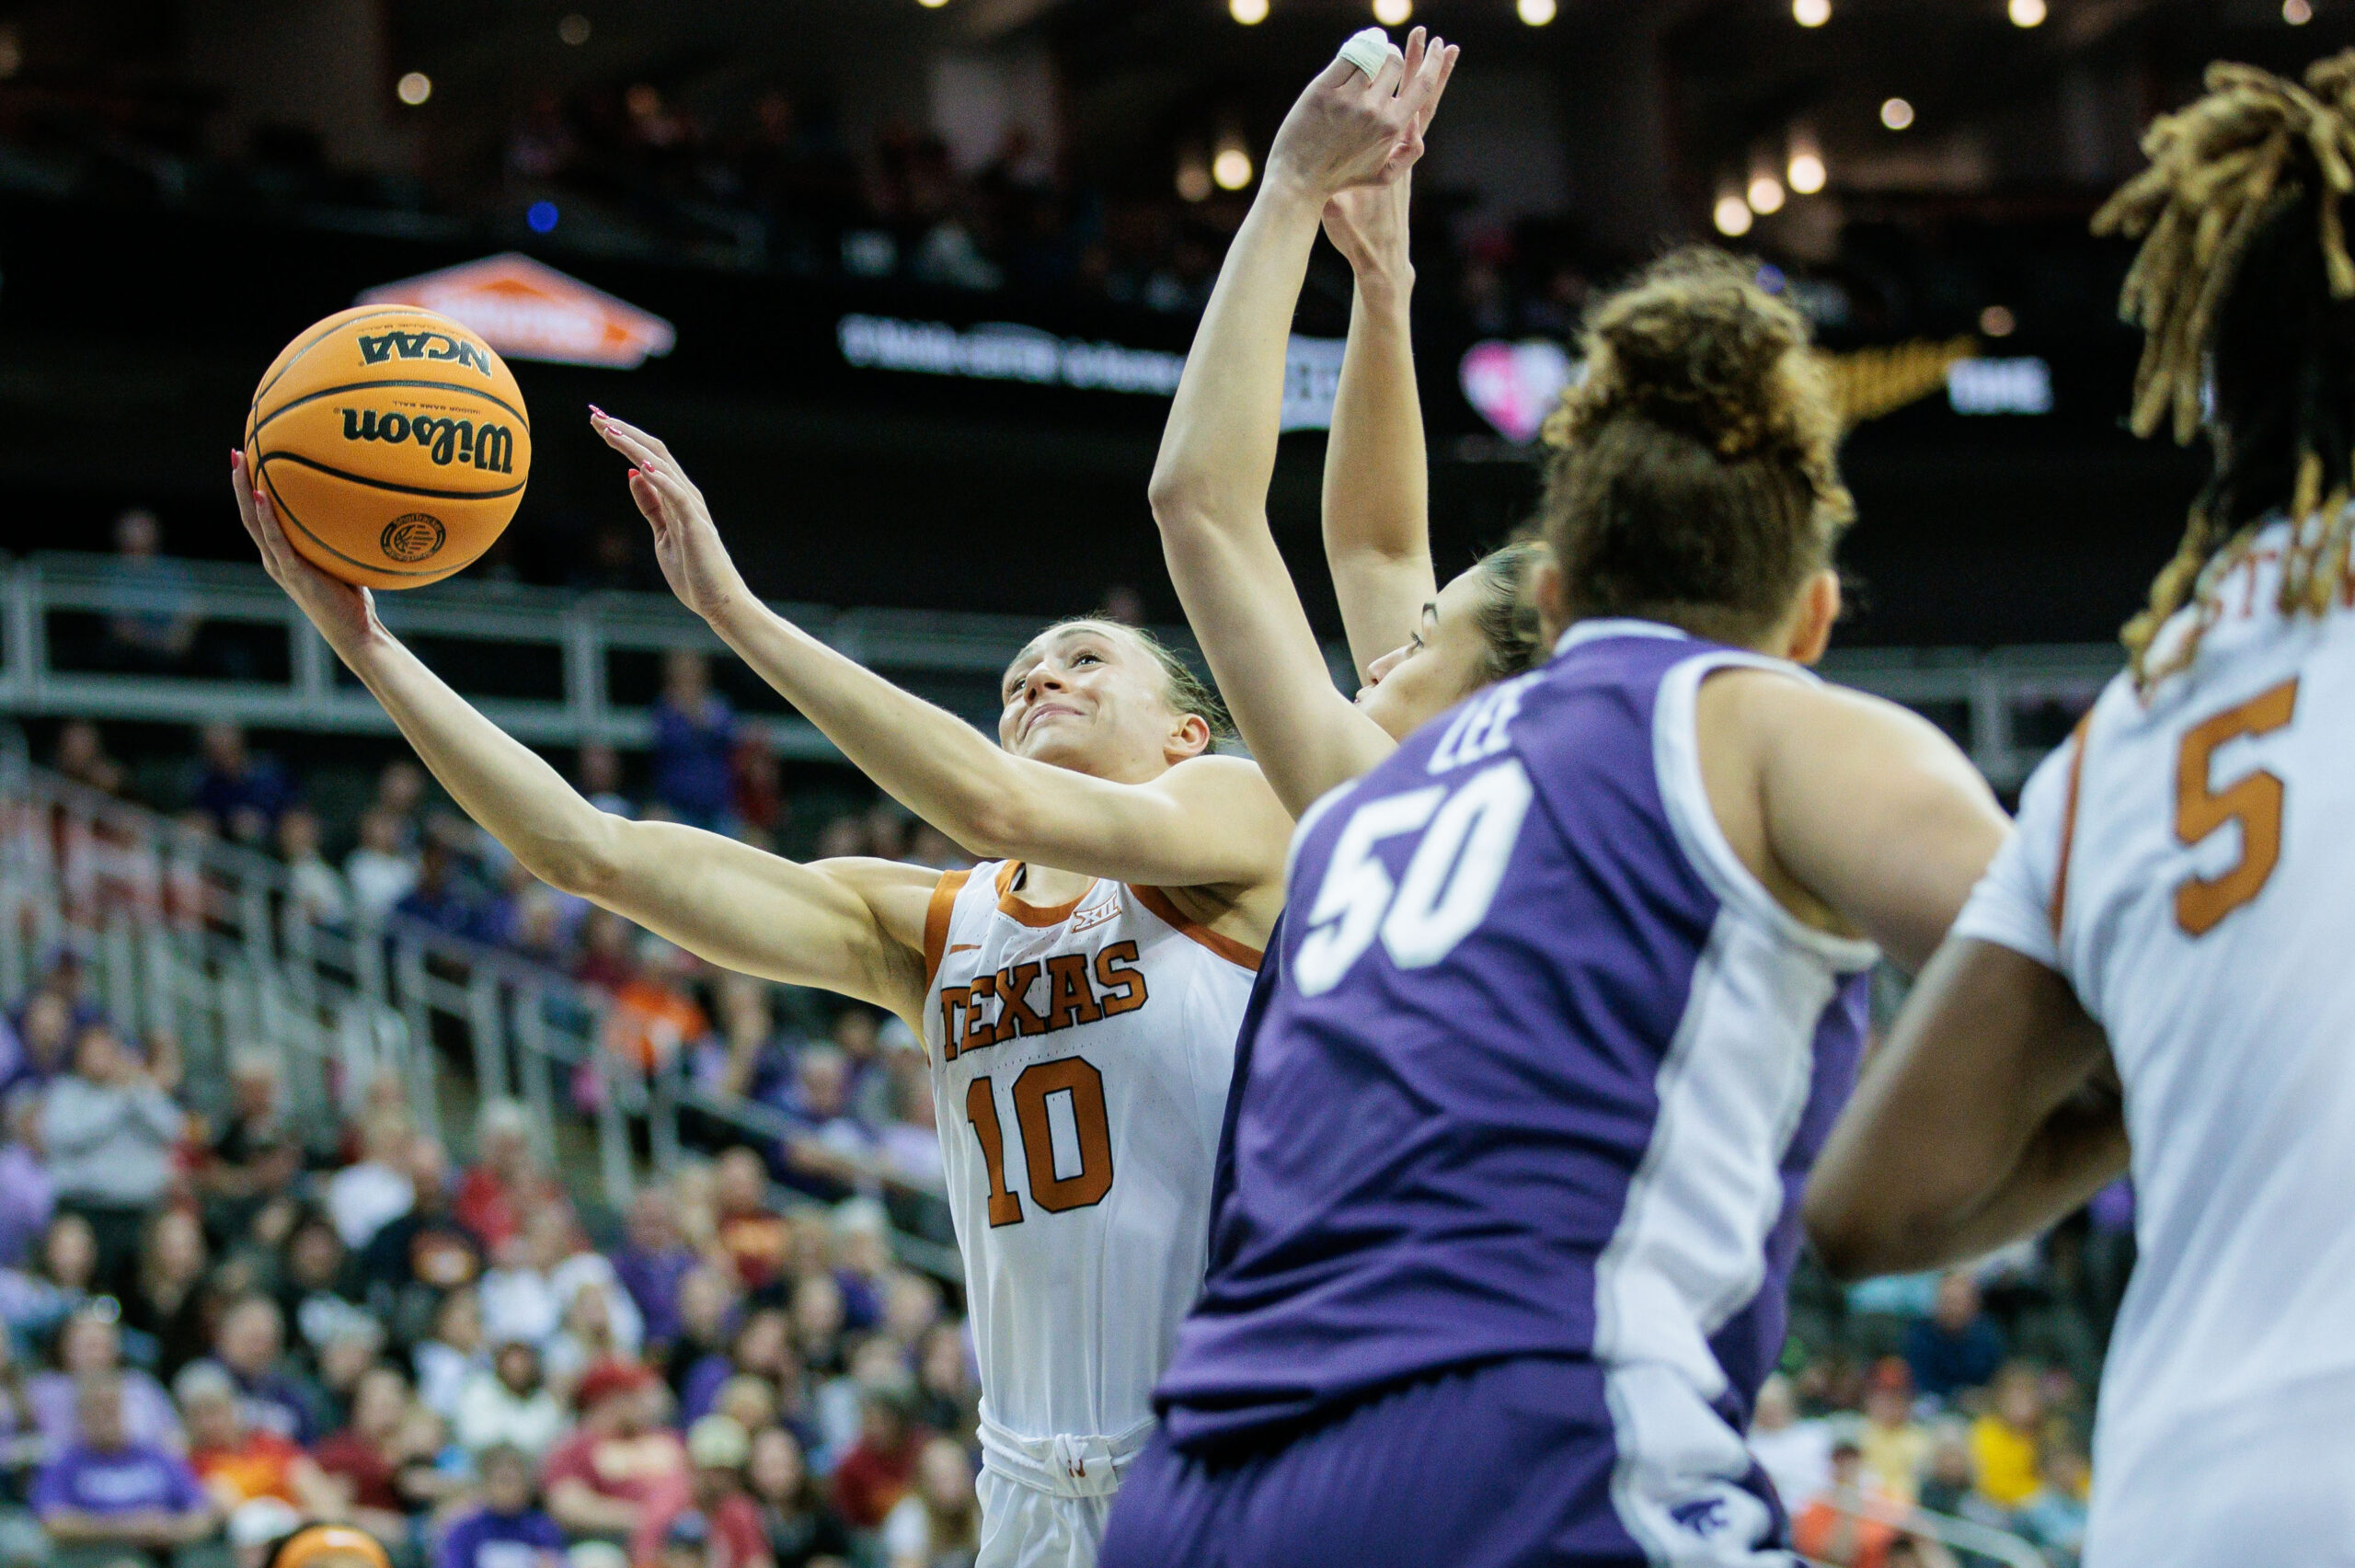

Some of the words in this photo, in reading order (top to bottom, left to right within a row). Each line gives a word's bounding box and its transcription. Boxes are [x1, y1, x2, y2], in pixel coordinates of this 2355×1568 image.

[357, 331, 492, 379] NCAA
[341, 408, 513, 475] Wilson
[1427, 670, 1547, 775] LEE
[2173, 674, 2301, 939] 5
[1292, 758, 1534, 998] 50
[940, 940, 1149, 1062] TEXAS
[966, 1055, 1113, 1229] 10
